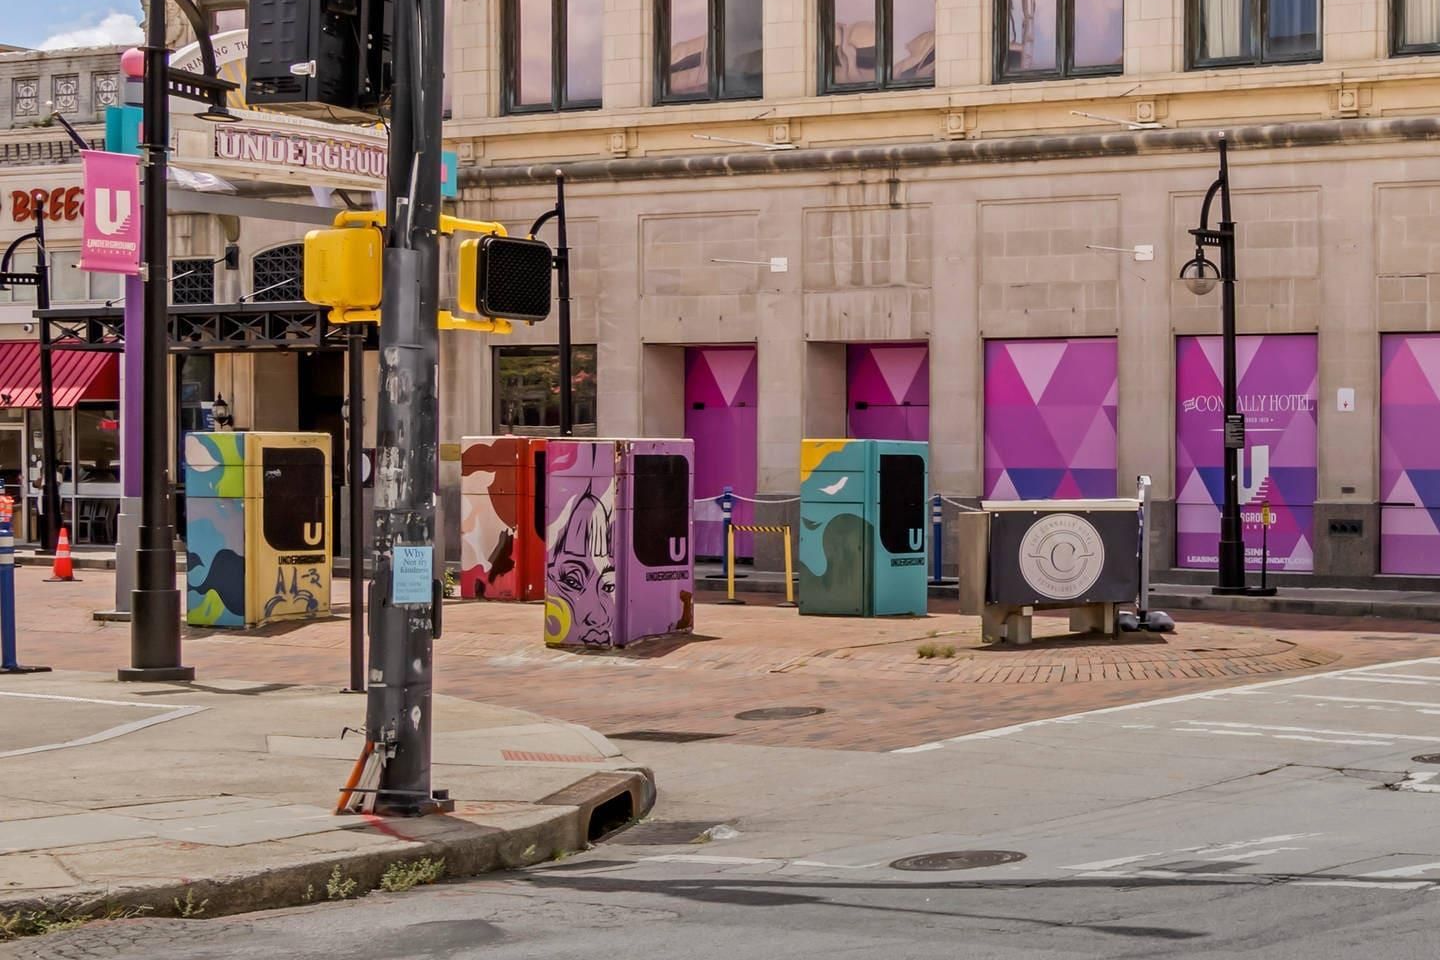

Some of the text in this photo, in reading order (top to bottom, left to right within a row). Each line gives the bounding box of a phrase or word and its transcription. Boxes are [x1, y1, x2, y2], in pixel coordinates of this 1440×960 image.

[217, 131, 388, 178] UNDERGROU
[87, 238, 137, 252] UNDERGROUND
[1195, 395, 1267, 412] CONALLY
[1270, 394, 1314, 411] HOTEL
[404, 548, 424, 560] Why
